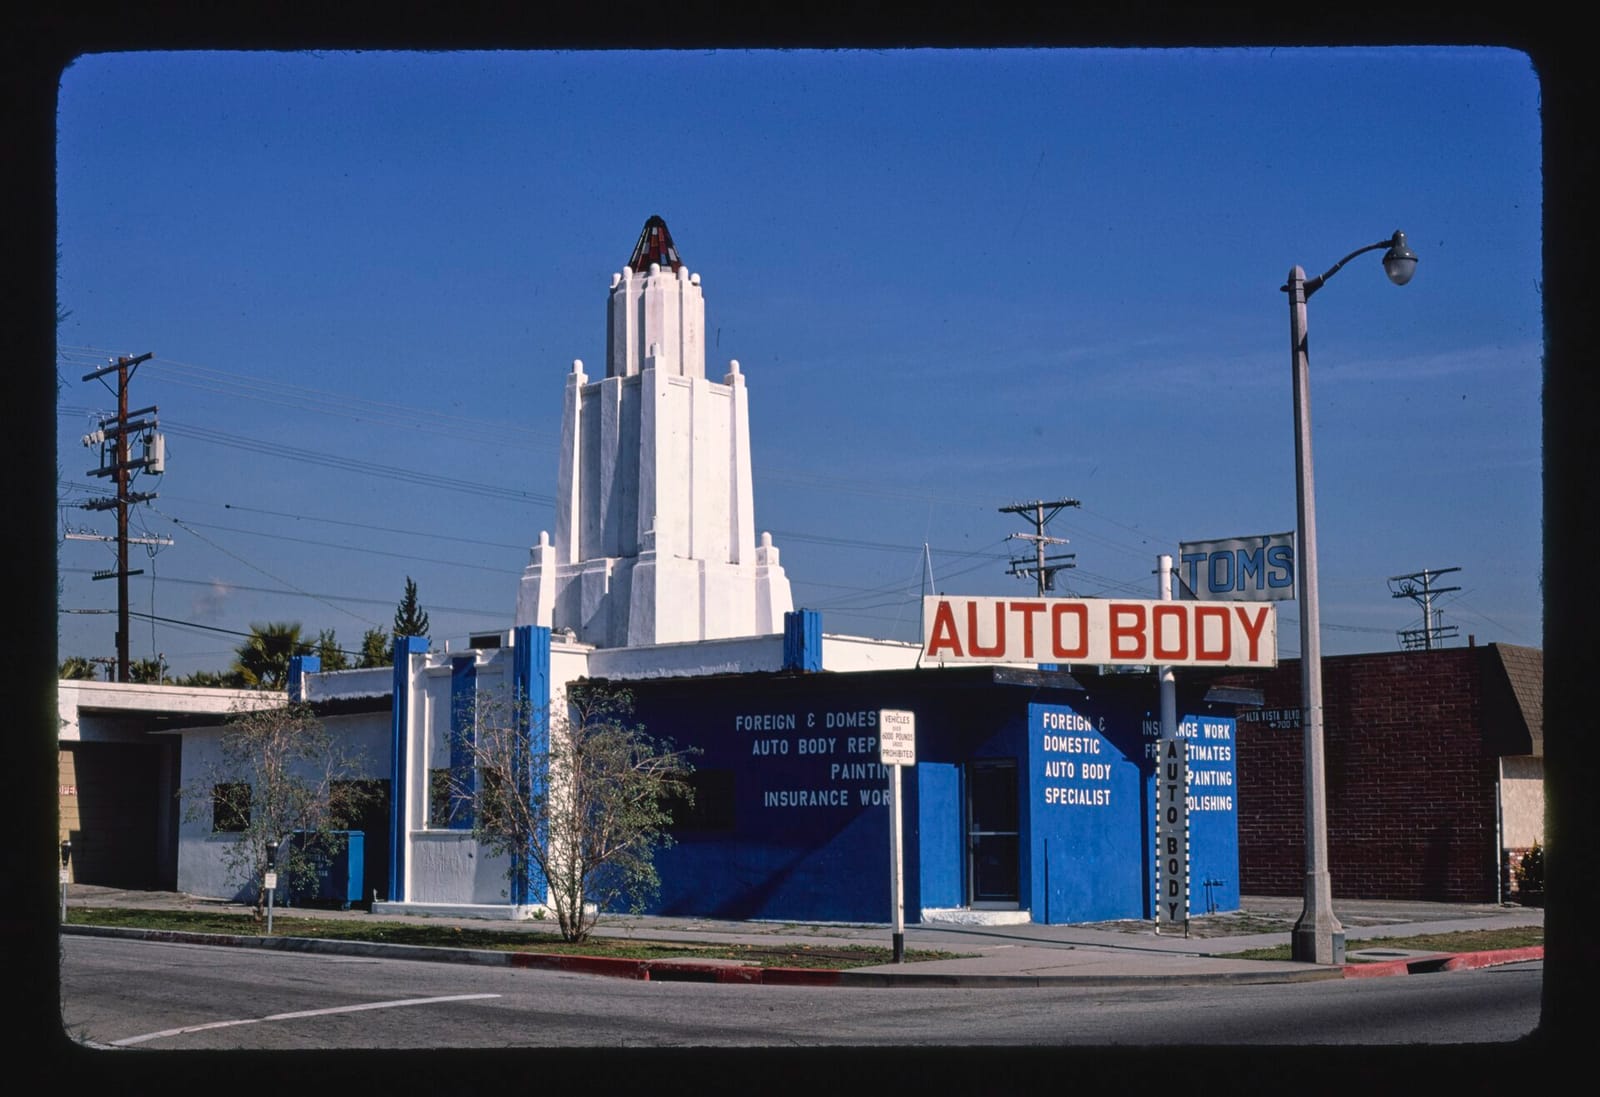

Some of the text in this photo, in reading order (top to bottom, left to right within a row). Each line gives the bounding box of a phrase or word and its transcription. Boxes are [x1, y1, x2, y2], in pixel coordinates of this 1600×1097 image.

[1182, 537, 1294, 595] TOM'S
[928, 601, 1269, 662] AUTO BODY
[736, 711, 881, 731] FOREIGN & DOMES
[885, 715, 910, 724] VEHICLES
[1043, 713, 1106, 731] FOREIGN &
[1246, 709, 1300, 722] ALTA VISTA BLVD
[895, 733, 913, 741] POUNDS
[1142, 720, 1230, 739] INSNCE WORK
[752, 737, 880, 756] AUTO BODY REP
[883, 749, 914, 758] PROHIBITED
[1044, 736, 1100, 754] DOMESTIC
[1189, 744, 1231, 761] TIMATES
[832, 763, 891, 780] PAINTIN
[1045, 762, 1111, 780] AUTO BODY
[1188, 771, 1232, 786] PAINTING
[765, 789, 891, 807] INSURANCE WOR
[1045, 788, 1111, 805] SPECIALIST
[1188, 796, 1232, 811] OLISHING
[1167, 741, 1179, 920] AUTO BODY
